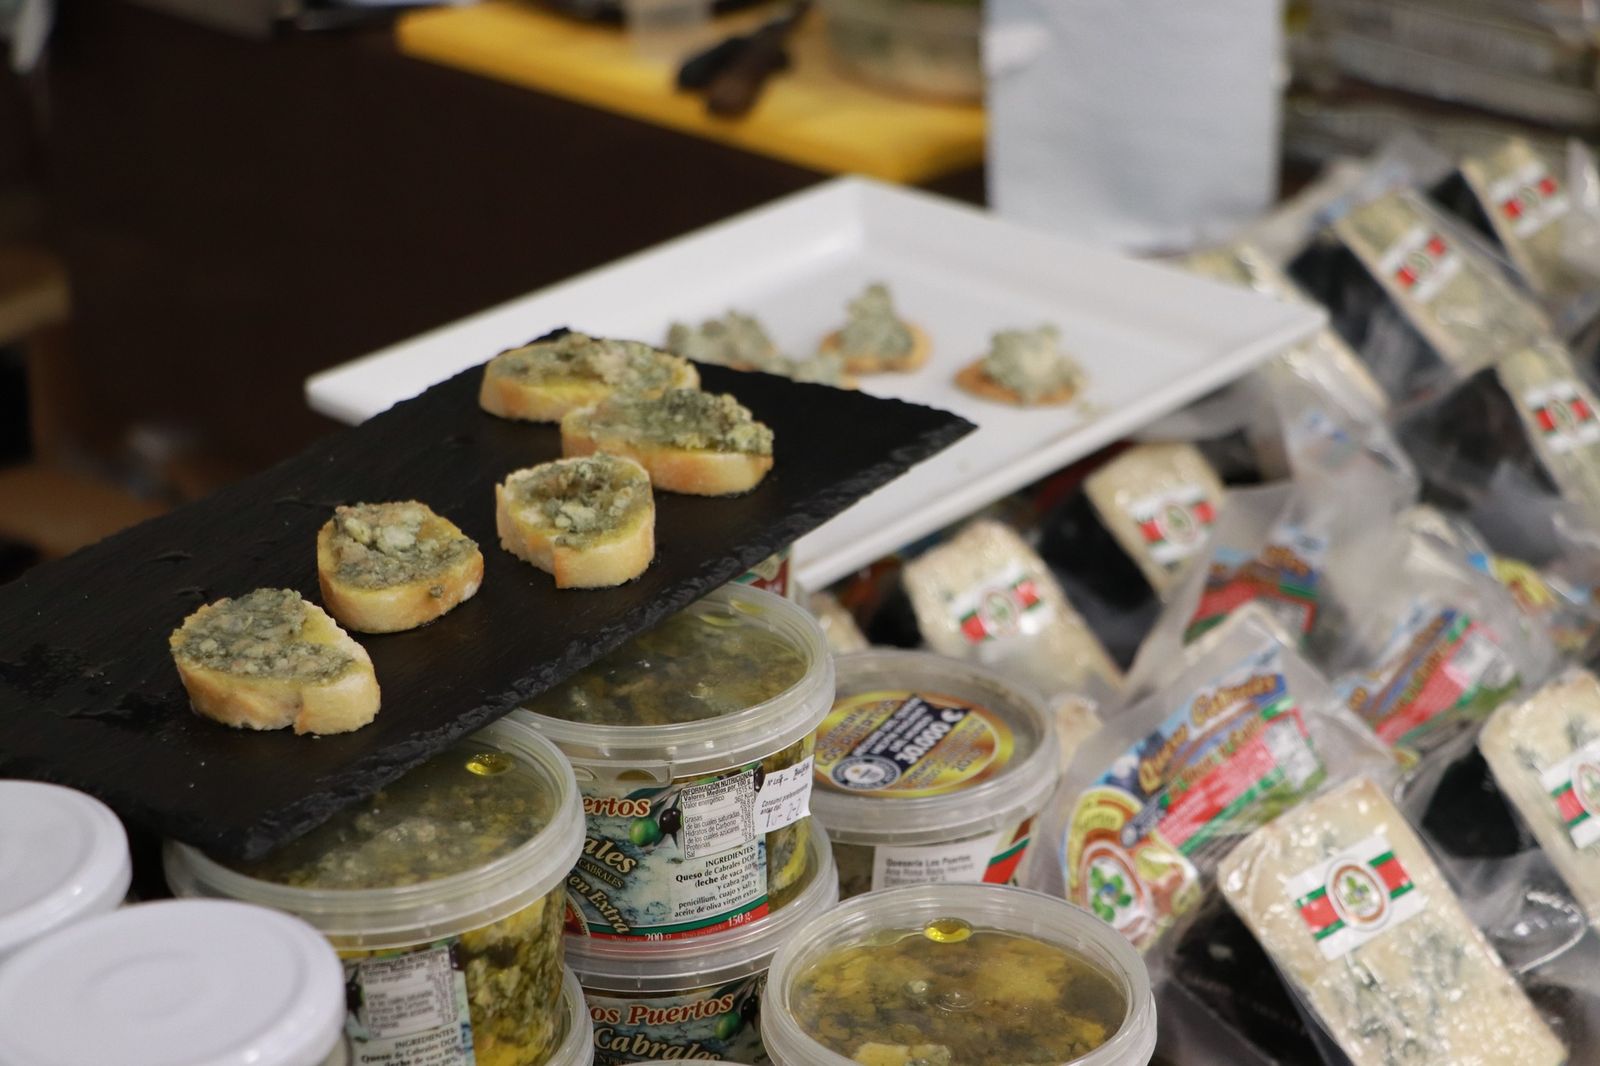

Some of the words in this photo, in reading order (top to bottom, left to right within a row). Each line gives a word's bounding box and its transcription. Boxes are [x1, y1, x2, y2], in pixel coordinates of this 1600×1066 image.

[683, 801, 698, 810] Valor
[684, 792, 706, 802] Valores
[685, 815, 703, 824] Grasas
[578, 857, 625, 890] CABRALES
[675, 872, 703, 884] Queso
[704, 868, 713, 877] de
[714, 859, 741, 875] Cabrales
[742, 852, 757, 865] DOP
[694, 876, 719, 888] (leche
[720, 872, 728, 881] de
[729, 868, 744, 879] vaca
[723, 878, 740, 890] cabra
[718, 888, 736, 901] cuajo
[587, 889, 631, 934] Extra
[674, 907, 696, 918] aceite
[696, 904, 706, 914] de
[706, 900, 722, 912] oliva
[723, 894, 743, 907] virgen
[728, 913, 744, 928] 150
[627, 994, 734, 1026] Puertos
